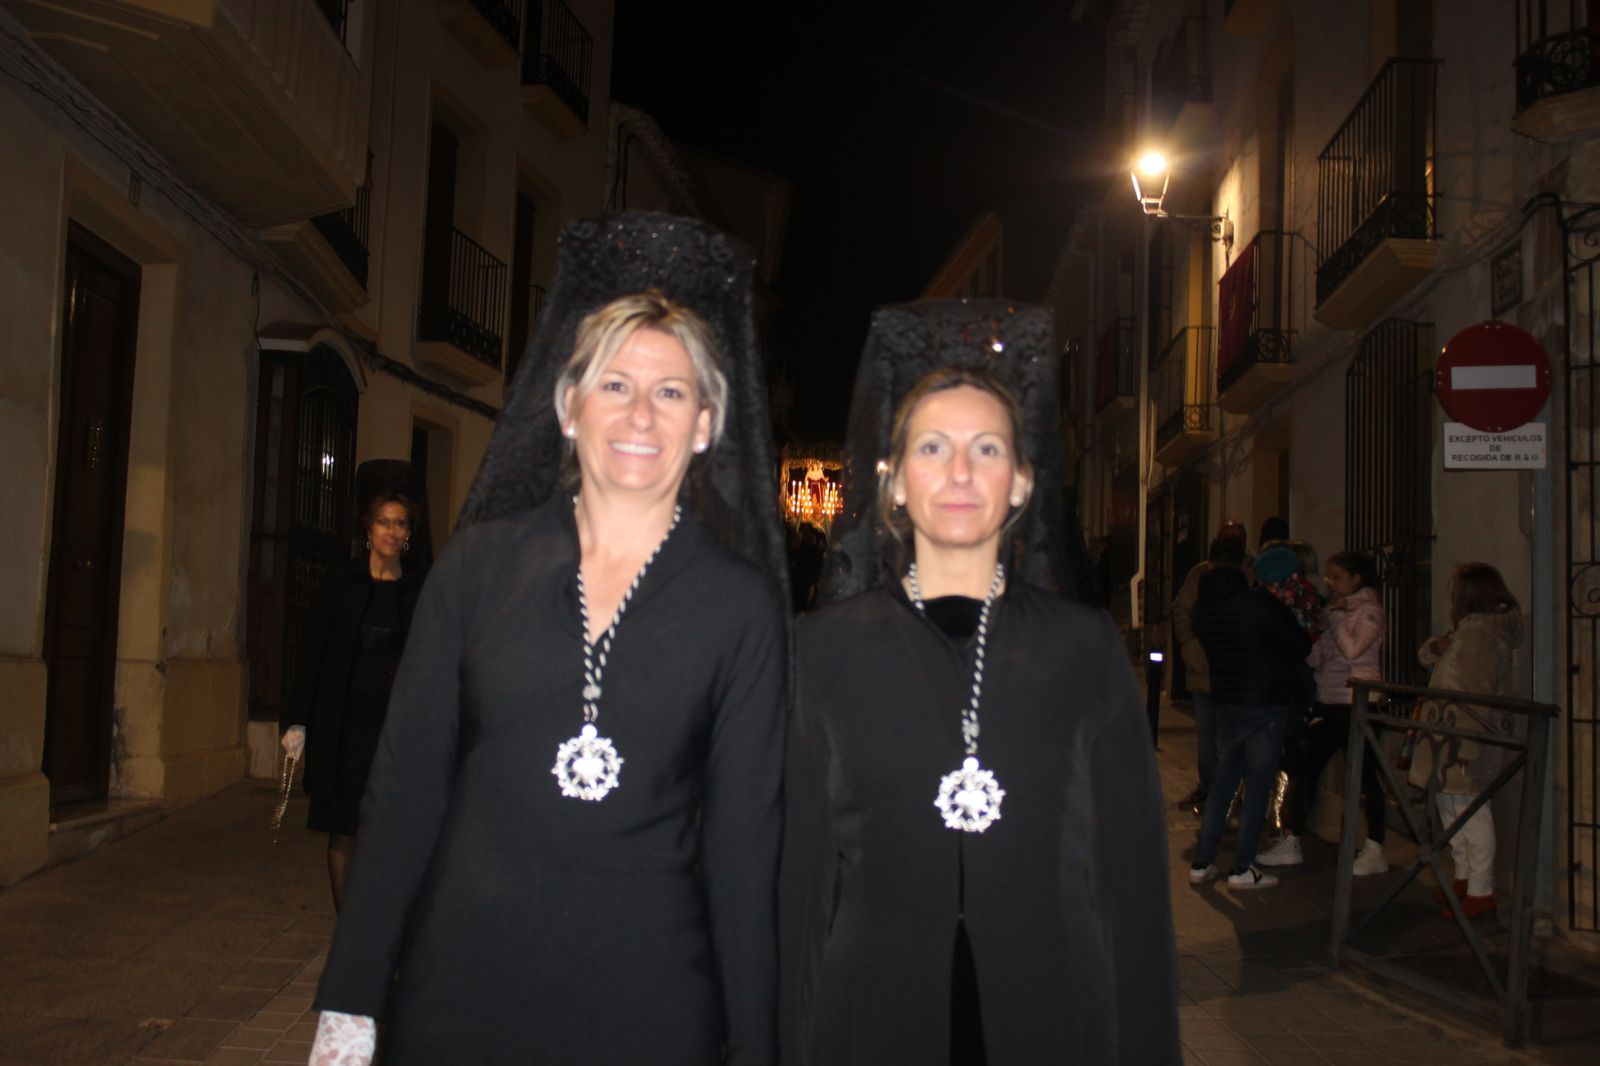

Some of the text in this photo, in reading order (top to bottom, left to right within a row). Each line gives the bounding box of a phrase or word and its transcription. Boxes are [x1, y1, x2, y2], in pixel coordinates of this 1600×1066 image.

[1448, 435, 1490, 443] EXCEPTO
[1489, 444, 1502, 452] DE
[1451, 454, 1498, 462] RECOGIDA
